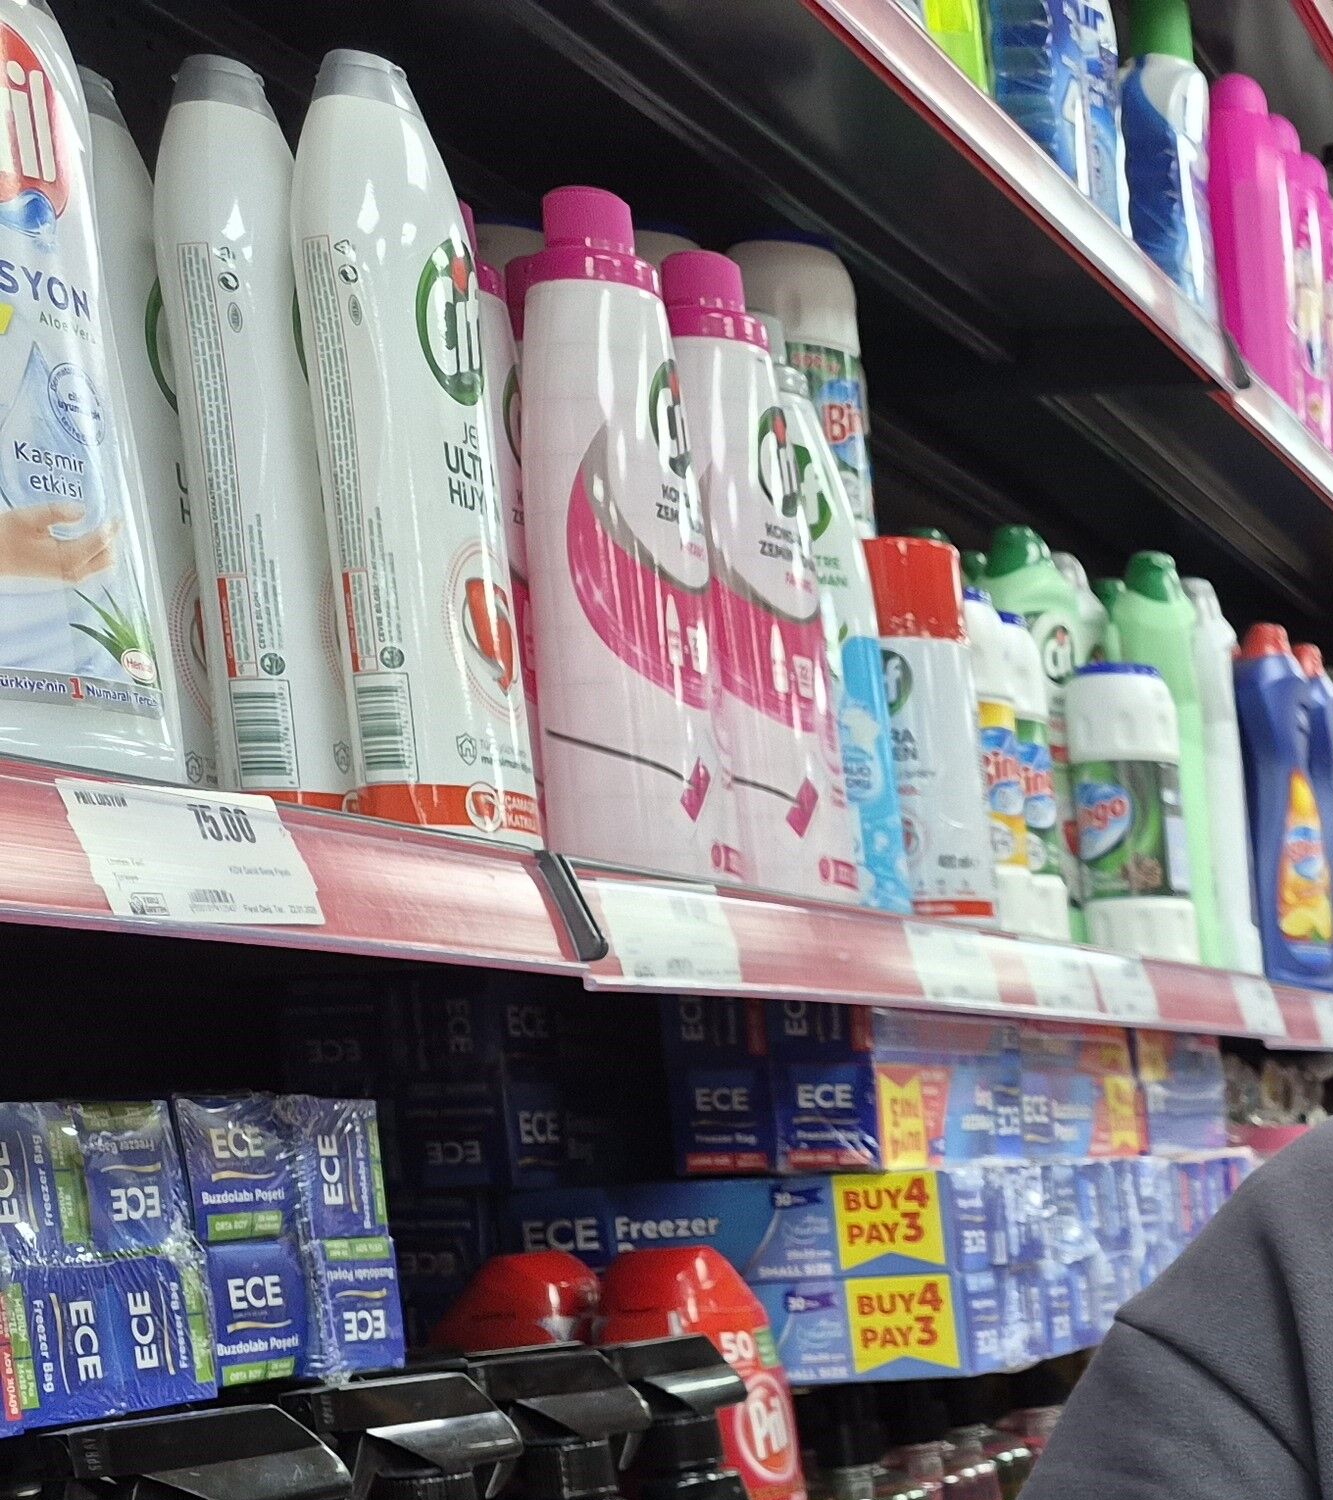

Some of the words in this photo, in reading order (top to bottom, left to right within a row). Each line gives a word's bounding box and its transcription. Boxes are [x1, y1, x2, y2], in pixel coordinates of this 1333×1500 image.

[0, 60, 56, 182] il
[462, 421, 482, 449] JE
[14, 440, 85, 473] Kaşmir
[30, 472, 84, 499] etkisi
[69, 677, 85, 700] 1
[187, 802, 257, 844] 75.00
[796, 1083, 854, 1109] ECE
[208, 1126, 267, 1159] ECE
[317, 1133, 345, 1207] ECE
[110, 1185, 163, 1223] ECE
[201, 1189, 255, 1205] Buzdolabı
[843, 1188, 902, 1213] BUY
[904, 1176, 930, 1208] 4
[523, 1218, 599, 1251] ECE
[614, 1216, 720, 1240] Freezer
[847, 1221, 900, 1245] PAY
[901, 1212, 925, 1244] 3
[228, 1274, 284, 1311] ECE
[856, 1292, 916, 1316] BUY
[917, 1282, 943, 1312] 4
[69, 1300, 104, 1382] ECE
[127, 1289, 160, 1371] ECE
[343, 1309, 387, 1342] ECE
[860, 1326, 913, 1349] PAY
[914, 1316, 939, 1346] 3
[33, 1299, 51, 1360] Freezer
[42, 1361, 55, 1394] Bag
[720, 1331, 755, 1362] 50
